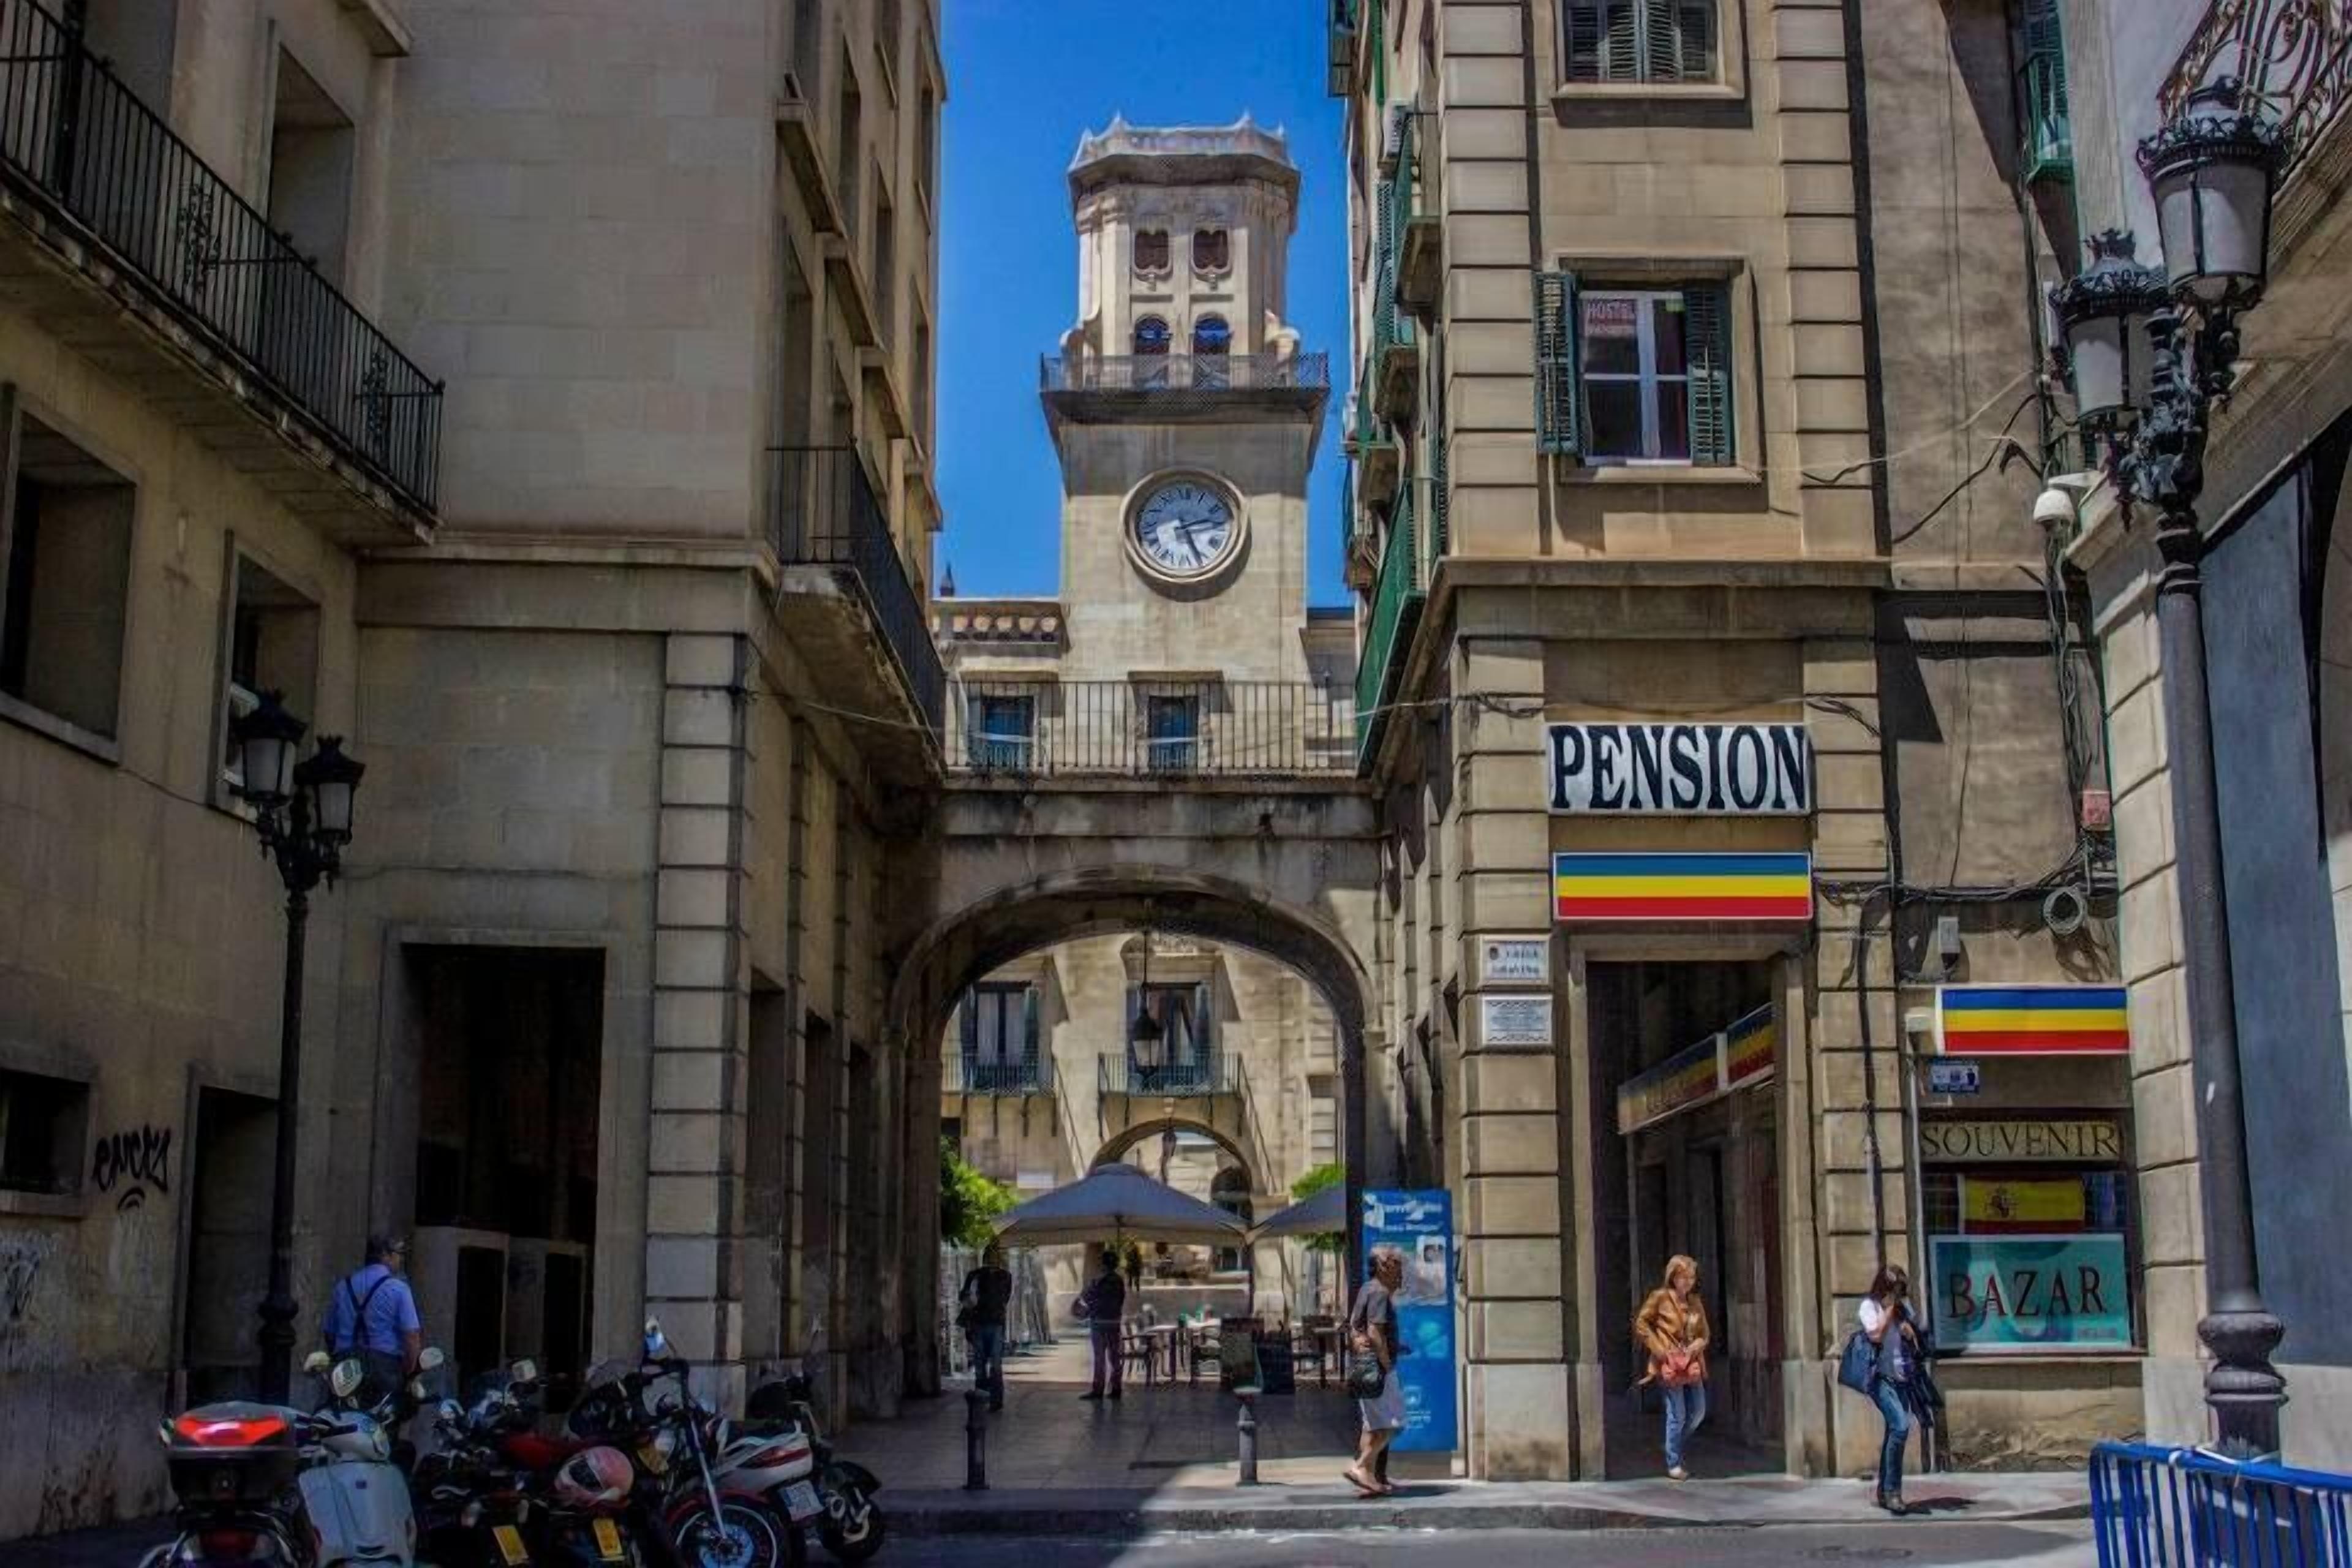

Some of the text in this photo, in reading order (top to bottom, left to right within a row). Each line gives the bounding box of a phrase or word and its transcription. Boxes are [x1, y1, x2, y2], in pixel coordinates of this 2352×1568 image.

[1550, 725, 1806, 810] PENSION
[1921, 1124, 2118, 1156] SOUVENIR
[1948, 1266, 2107, 1317] BAZAR
